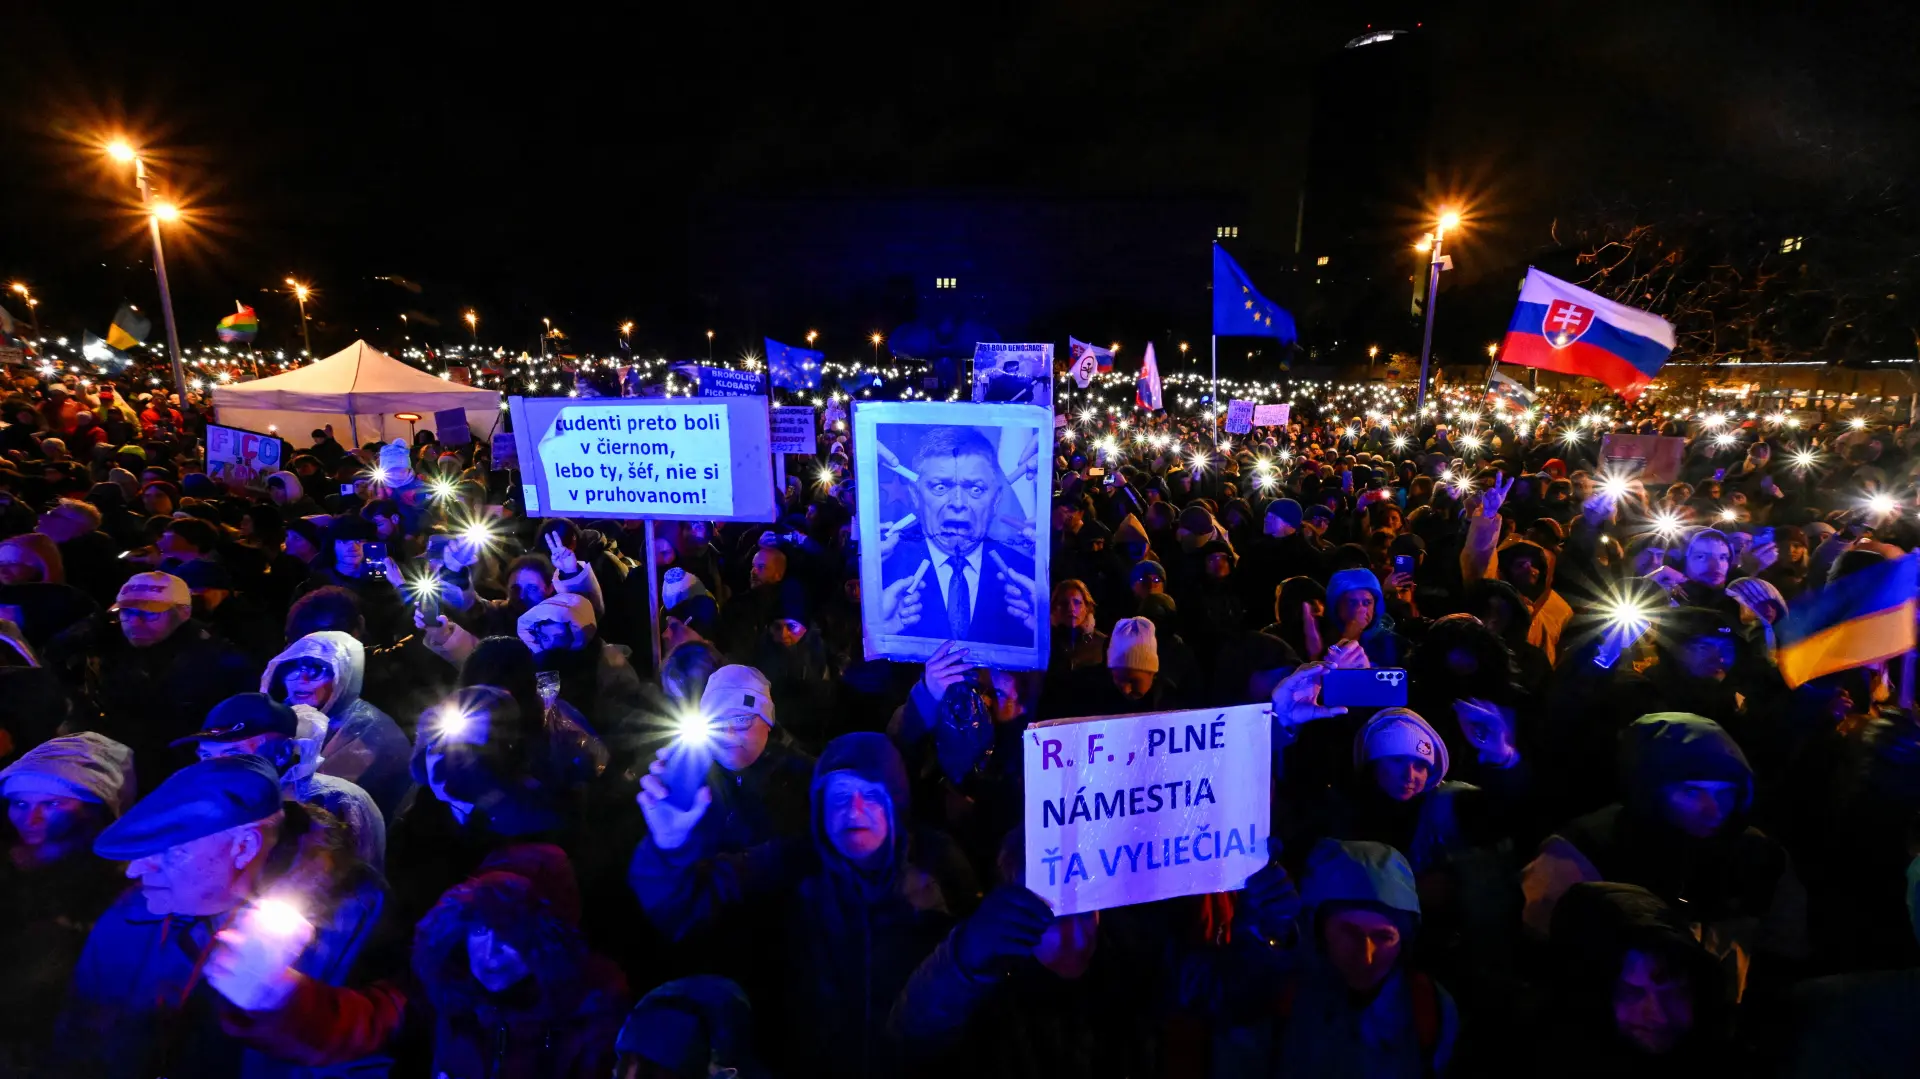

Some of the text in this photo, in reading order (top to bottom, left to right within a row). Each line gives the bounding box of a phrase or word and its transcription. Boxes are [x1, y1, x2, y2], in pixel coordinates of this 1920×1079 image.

[556, 413, 720, 433] tudenti preto boli
[211, 428, 279, 465] FICO
[580, 437, 676, 458] v čiernom,
[555, 461, 719, 482] lebo ty, šéf, nie si
[569, 486, 707, 505] v pruhovanom!
[1042, 739, 1074, 770] R.
[1148, 714, 1226, 757] PLNÉ
[1043, 778, 1216, 828] NÁMESTIA
[1041, 823, 1256, 886] ŤA VYLIEČIA!
